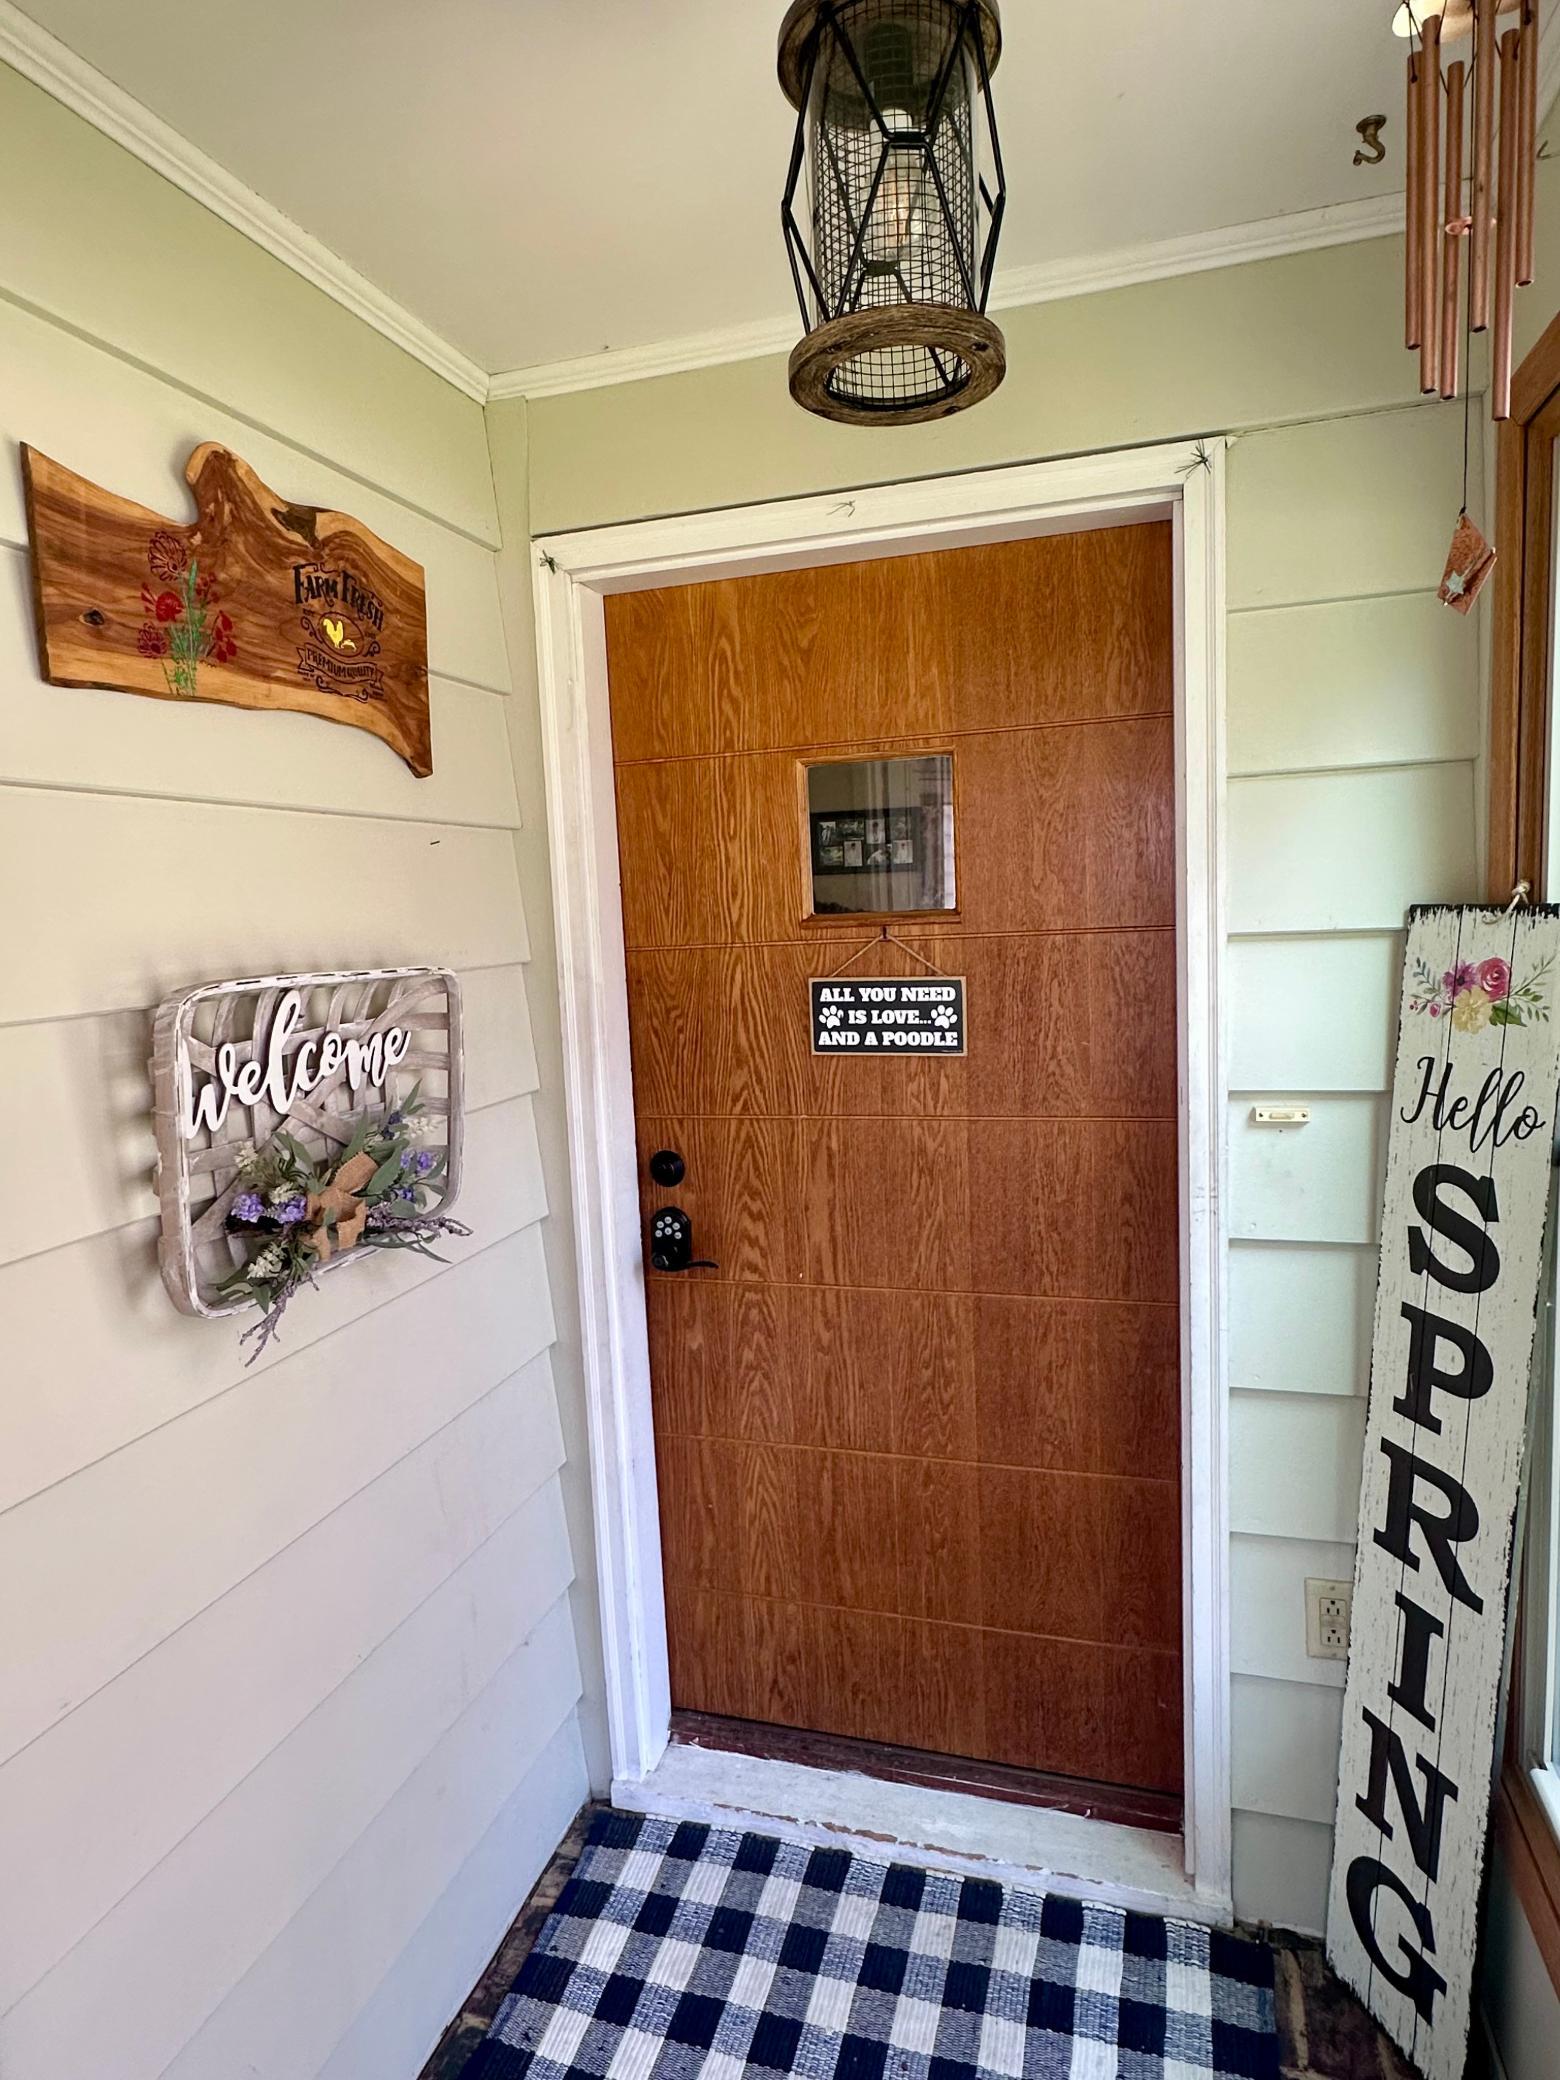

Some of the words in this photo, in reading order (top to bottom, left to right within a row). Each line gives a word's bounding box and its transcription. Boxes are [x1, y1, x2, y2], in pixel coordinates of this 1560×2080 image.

[307, 649, 347, 678] PREMIUM
[819, 987, 855, 1002] ALL
[859, 987, 897, 1002] YOU
[900, 986, 956, 1002] NEED
[848, 1010, 867, 1024] IS
[871, 1010, 932, 1024] LOVE...
[818, 1031, 860, 1046] AND
[864, 1031, 878, 1046] A
[882, 1031, 958, 1047] POODLE
[1400, 1056, 1546, 1154] Hello
[1346, 1164, 1501, 2027] SPRING
